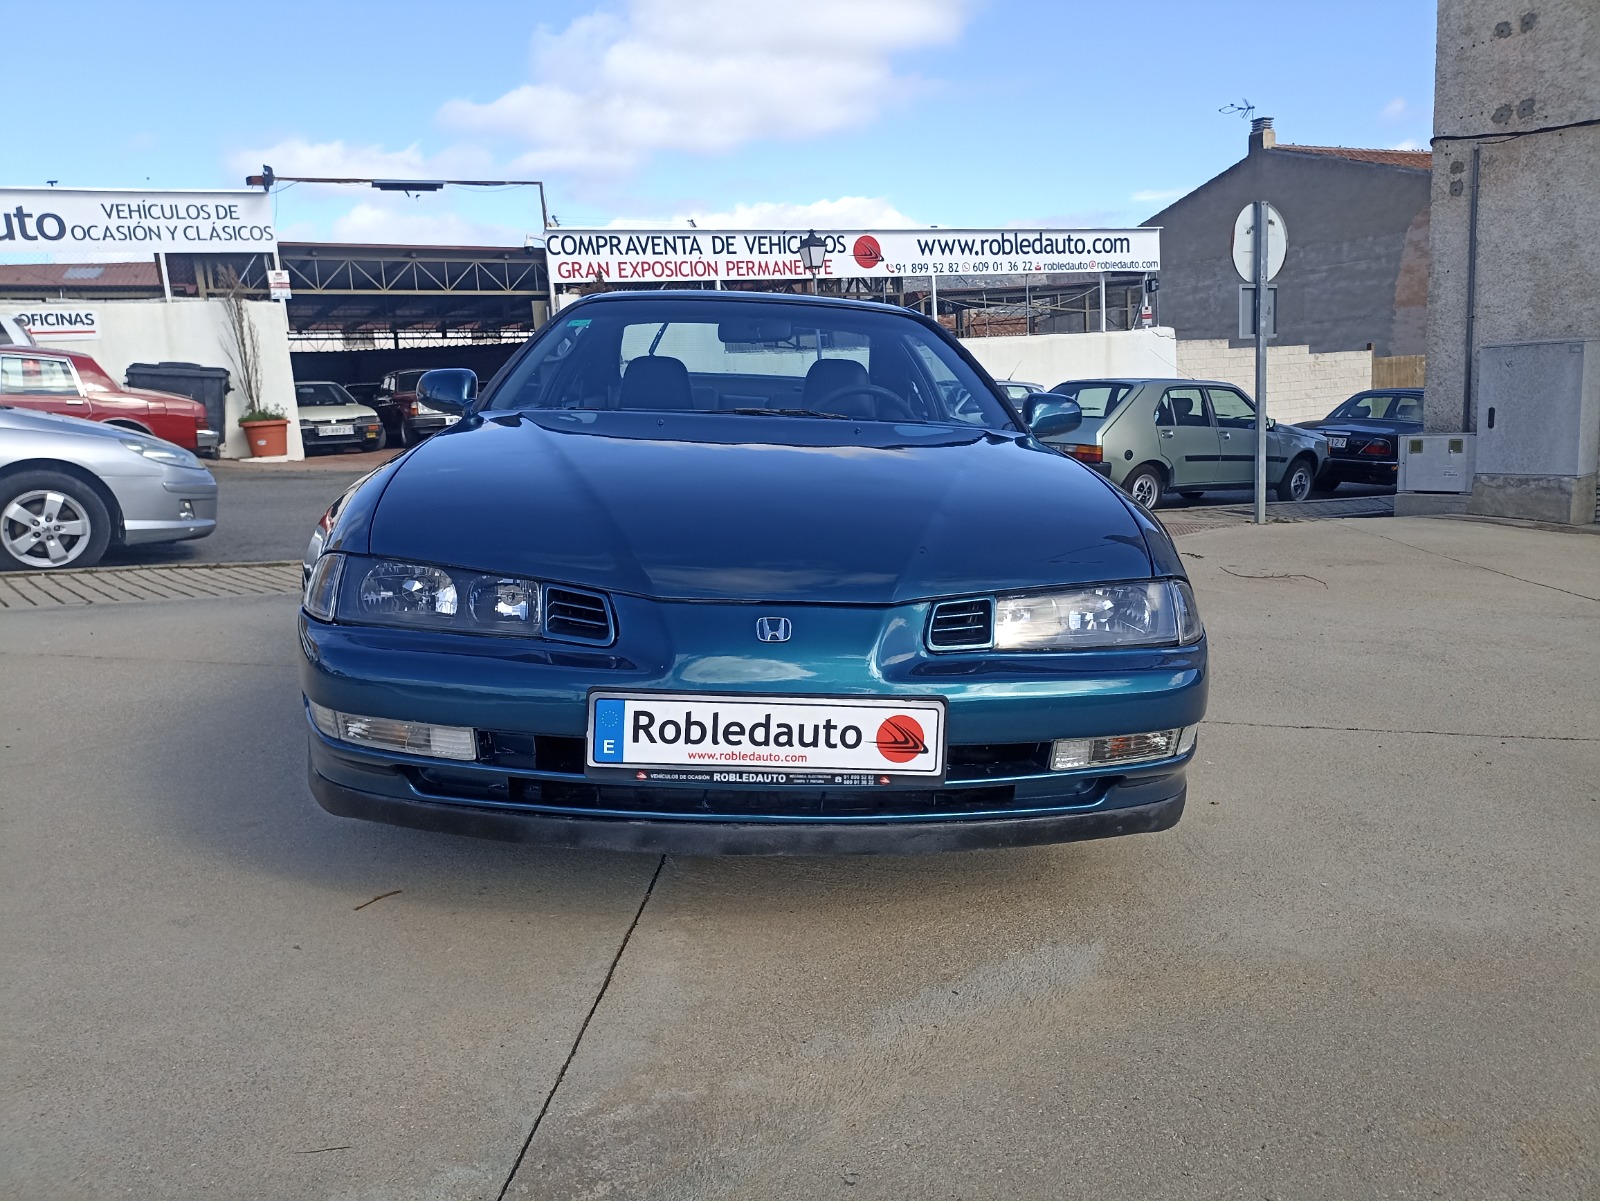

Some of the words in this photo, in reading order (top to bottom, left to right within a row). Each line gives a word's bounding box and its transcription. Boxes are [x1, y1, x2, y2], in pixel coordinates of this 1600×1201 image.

[100, 200, 211, 220] VEHÍCULOS
[215, 204, 240, 220] DE
[71, 222, 162, 241] OCASIÓN
[165, 225, 178, 241] Y
[183, 222, 274, 241] CLÁSICOS
[546, 235, 703, 255] COMPRAVENTA
[711, 235, 737, 255] DE
[744, 231, 847, 255] VEHÍCOS
[916, 232, 1130, 256] www.robledauto.com
[557, 261, 611, 279] GRAN
[617, 257, 719, 278] EXPOSICIÓN
[895, 263, 907, 274] 91
[911, 262, 929, 274] 899
[932, 262, 945, 273] 52
[948, 262, 960, 273] 82
[972, 261, 990, 272] 609
[992, 261, 1004, 272] 01
[1007, 261, 1019, 272] 36
[1022, 261, 1033, 272] 22
[1043, 260, 1159, 271] robledauto@robledauto.com
[632, 710, 863, 750] Robledauto
[602, 739, 616, 754] E
[687, 751, 808, 763] www.robledauto.com
[713, 772, 786, 783] ROBLEDAUTO
